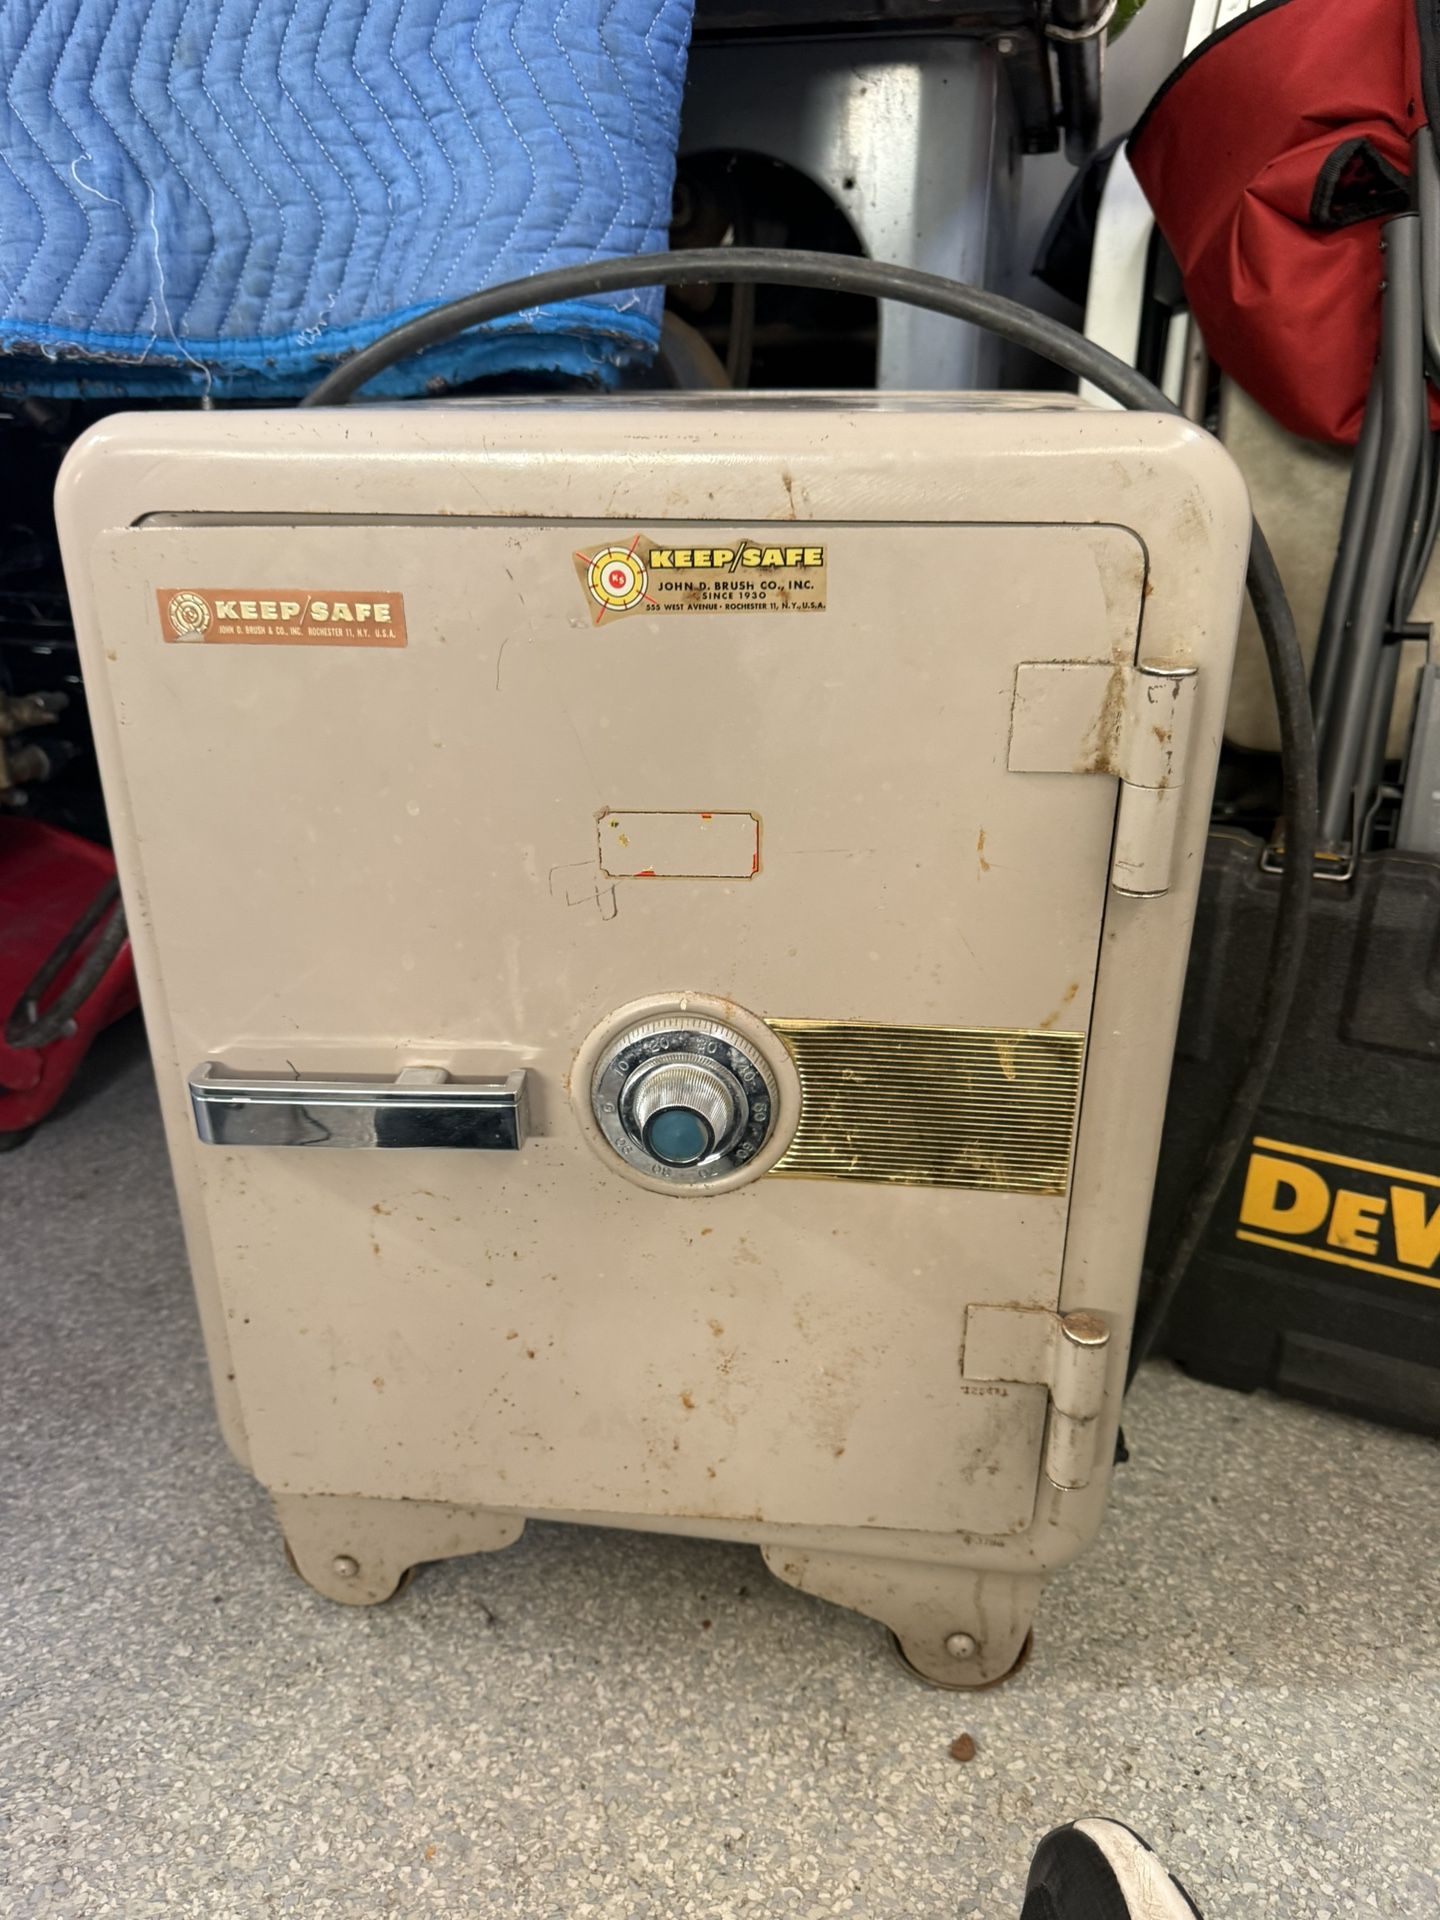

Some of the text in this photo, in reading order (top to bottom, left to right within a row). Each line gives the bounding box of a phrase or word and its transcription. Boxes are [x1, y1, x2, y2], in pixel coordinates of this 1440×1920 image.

[649, 541, 823, 573] KEEP/SAFE
[658, 581, 814, 591] JOHN D. BRUSH CO., INC.
[702, 592, 766, 600] SINCE 1930
[215, 595, 391, 624] KEEP/SAFE
[688, 603, 718, 611] AVENUE
[219, 625, 234, 634] JOHN
[236, 626, 243, 634] D.
[245, 625, 266, 635] BRUSH
[268, 626, 274, 635] &
[290, 627, 304, 635] INC.
[308, 627, 343, 637] ROCHESTER
[357, 629, 370, 638] N.Y.
[375, 629, 396, 639] U.S.A.
[614, 1059, 631, 1078] 10
